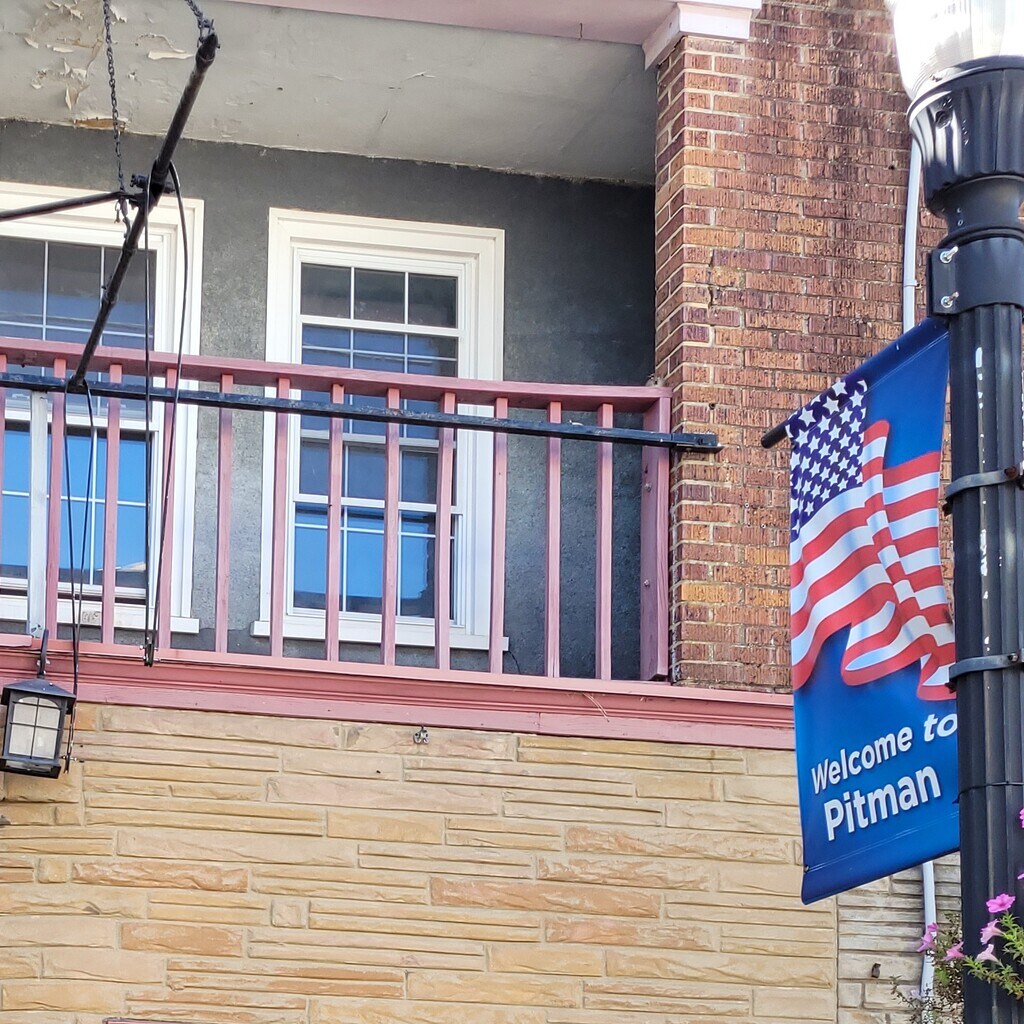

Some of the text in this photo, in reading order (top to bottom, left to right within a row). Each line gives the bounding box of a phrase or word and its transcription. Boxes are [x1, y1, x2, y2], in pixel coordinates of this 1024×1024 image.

[810, 713, 957, 795] Welcome to
[823, 765, 942, 842] Pitman
